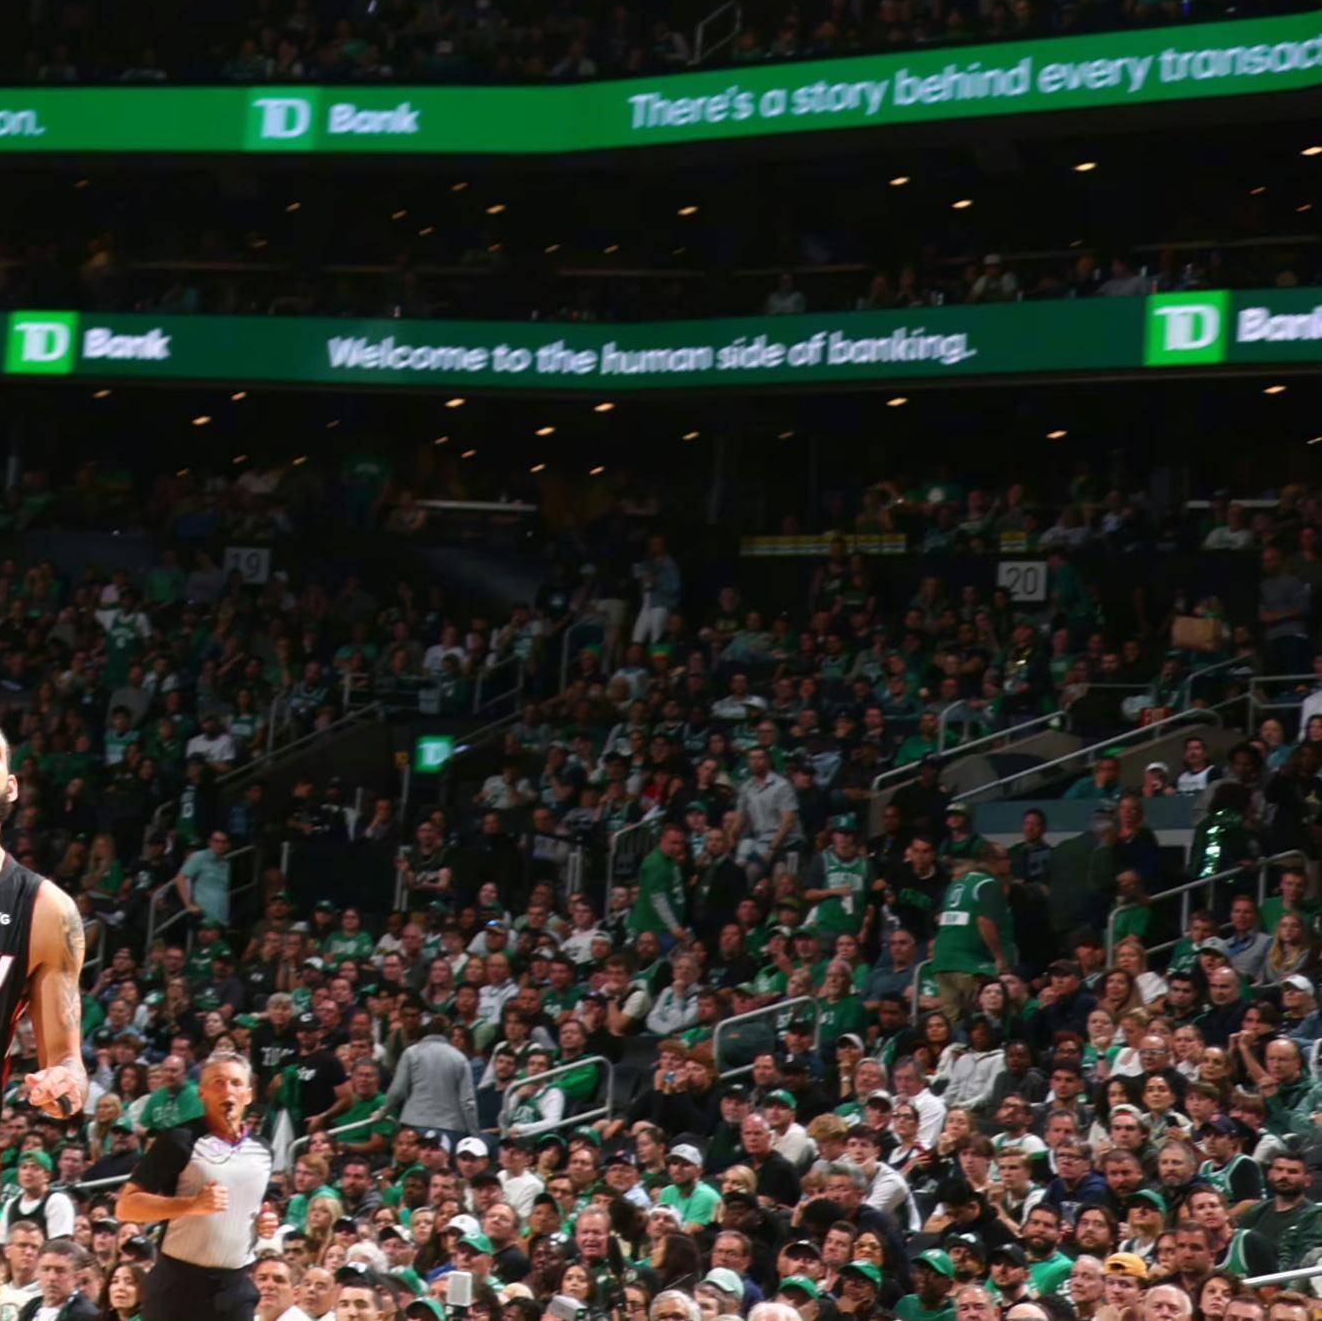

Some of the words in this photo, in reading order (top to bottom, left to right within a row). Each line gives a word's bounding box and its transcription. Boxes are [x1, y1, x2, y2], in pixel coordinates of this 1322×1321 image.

[629, 86, 754, 130] There's
[759, 91, 787, 120] a
[790, 75, 889, 125] story
[893, 57, 1034, 108] behind
[1038, 48, 1154, 96] every
[1159, 33, 1322, 84] transac
[254, 98, 310, 138] TD
[328, 100, 420, 135] Bank
[13, 323, 69, 361] TD
[83, 327, 171, 361] Bank
[1153, 304, 1221, 351] TD
[328, 335, 487, 372] Welcome
[493, 342, 529, 372] to
[535, 339, 596, 375] the
[600, 340, 712, 376] human
[717, 335, 785, 370] side
[788, 331, 825, 365] of
[827, 326, 977, 367] banking.
[1006, 566, 1039, 595] 20
